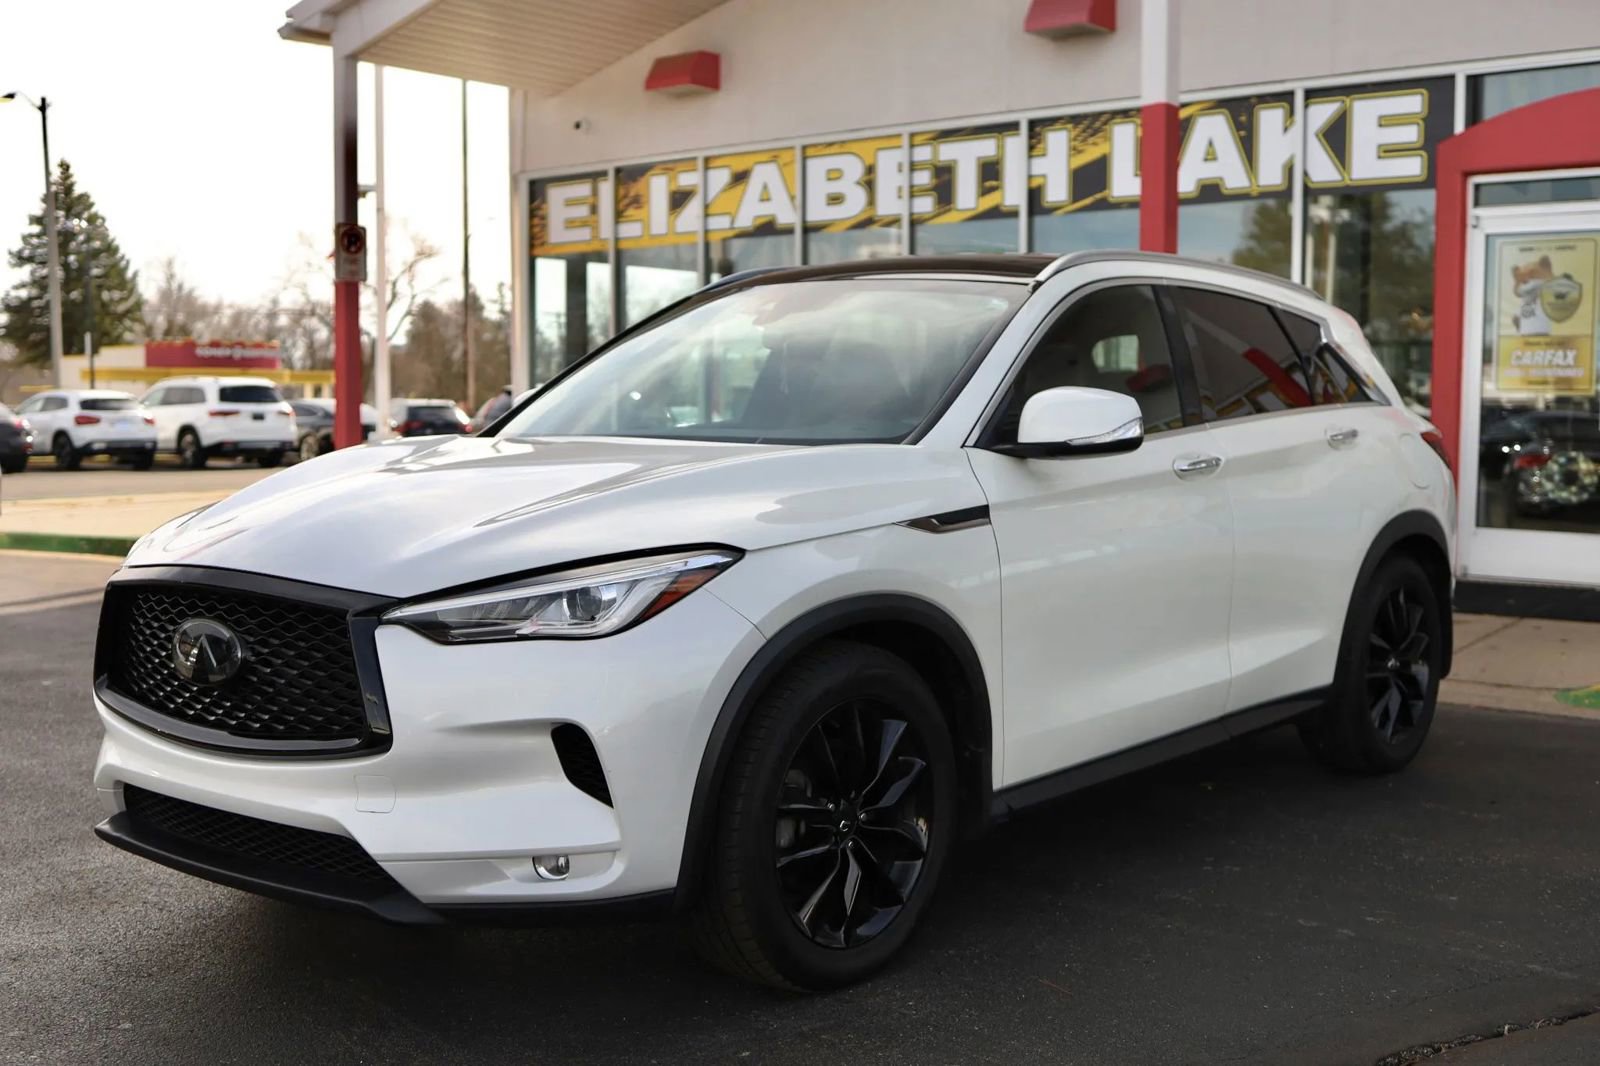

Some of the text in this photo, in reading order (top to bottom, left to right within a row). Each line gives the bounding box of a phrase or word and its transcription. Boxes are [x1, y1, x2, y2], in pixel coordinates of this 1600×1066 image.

[546, 88, 1429, 244] ELIZABETH LAKE
[1511, 348, 1577, 367] CARFAX
